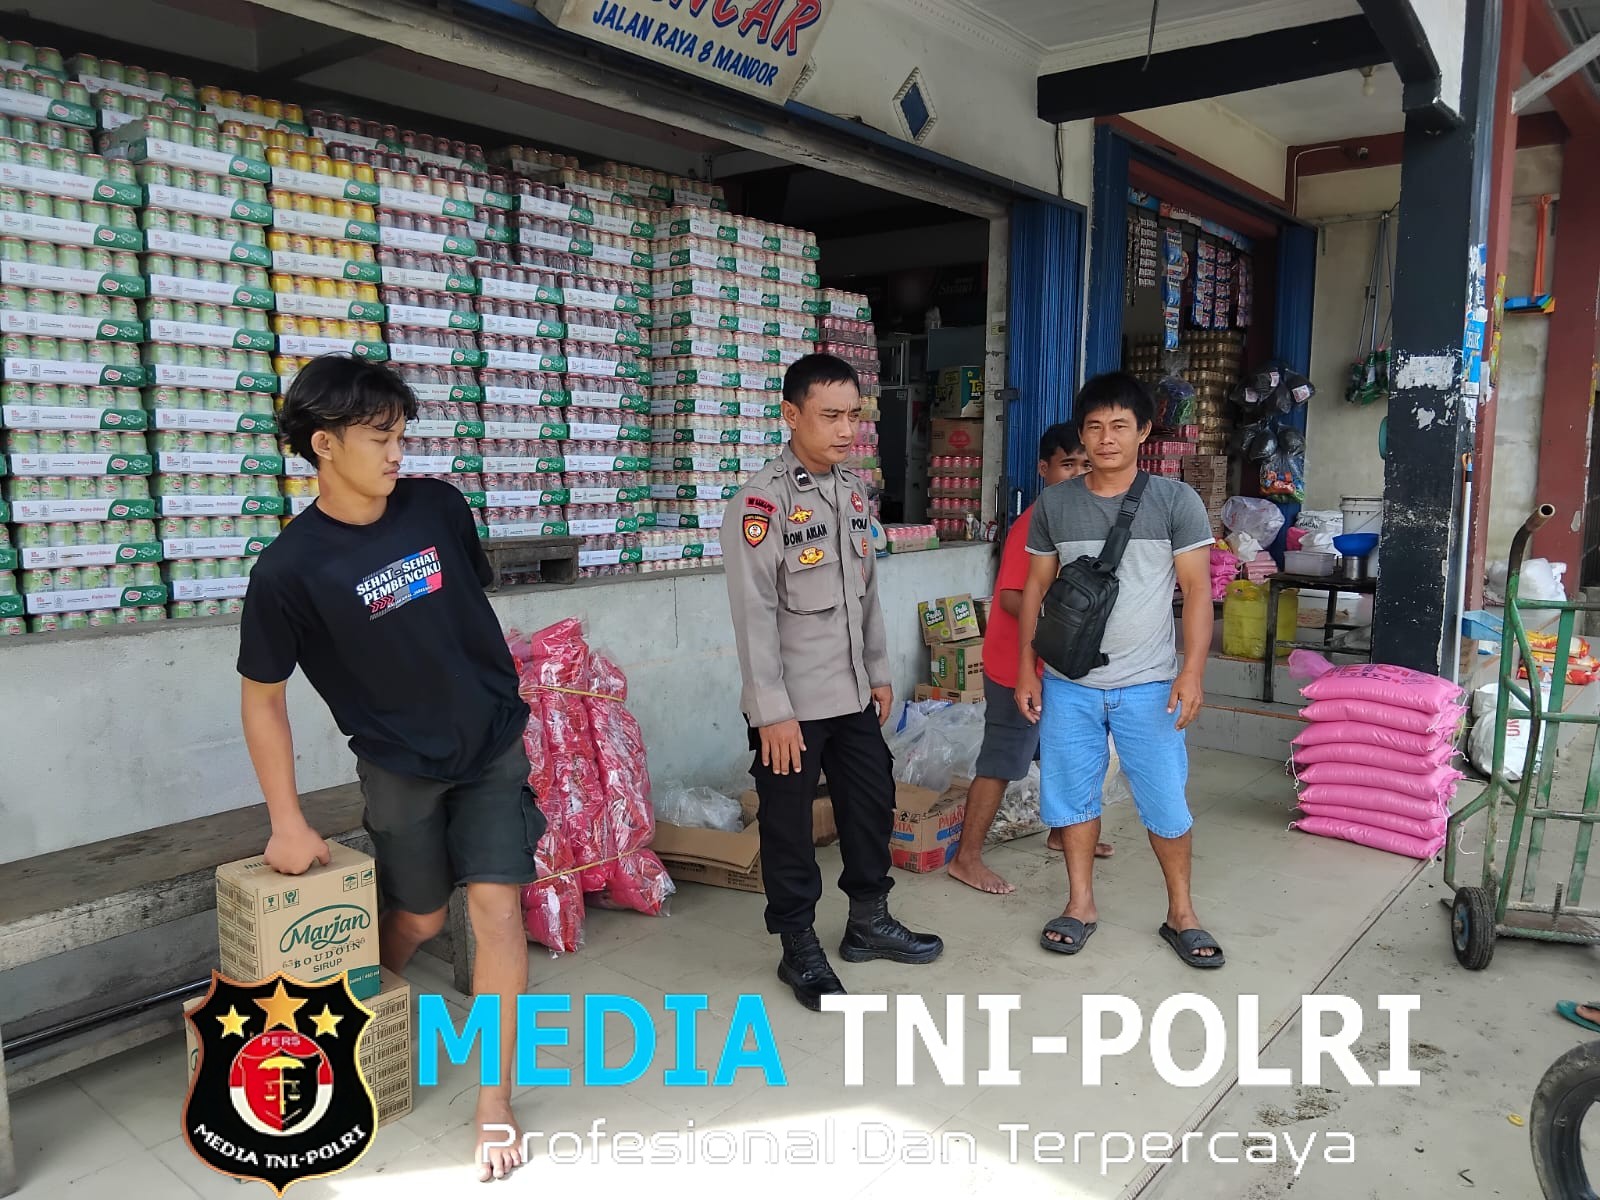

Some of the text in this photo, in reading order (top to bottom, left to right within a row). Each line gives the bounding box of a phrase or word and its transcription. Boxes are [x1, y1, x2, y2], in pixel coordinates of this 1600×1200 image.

[592, 1, 654, 42] JALAN
[652, 22, 698, 58] RAYA
[712, 45, 779, 87] MANDOR
[356, 568, 393, 596] SEHAT
[402, 550, 436, 573] SEHAT
[363, 561, 441, 606] PEMBENCIKU
[280, 908, 370, 953] Marjan
[294, 942, 361, 969] BOUDOIN
[313, 958, 343, 973] SIRUP
